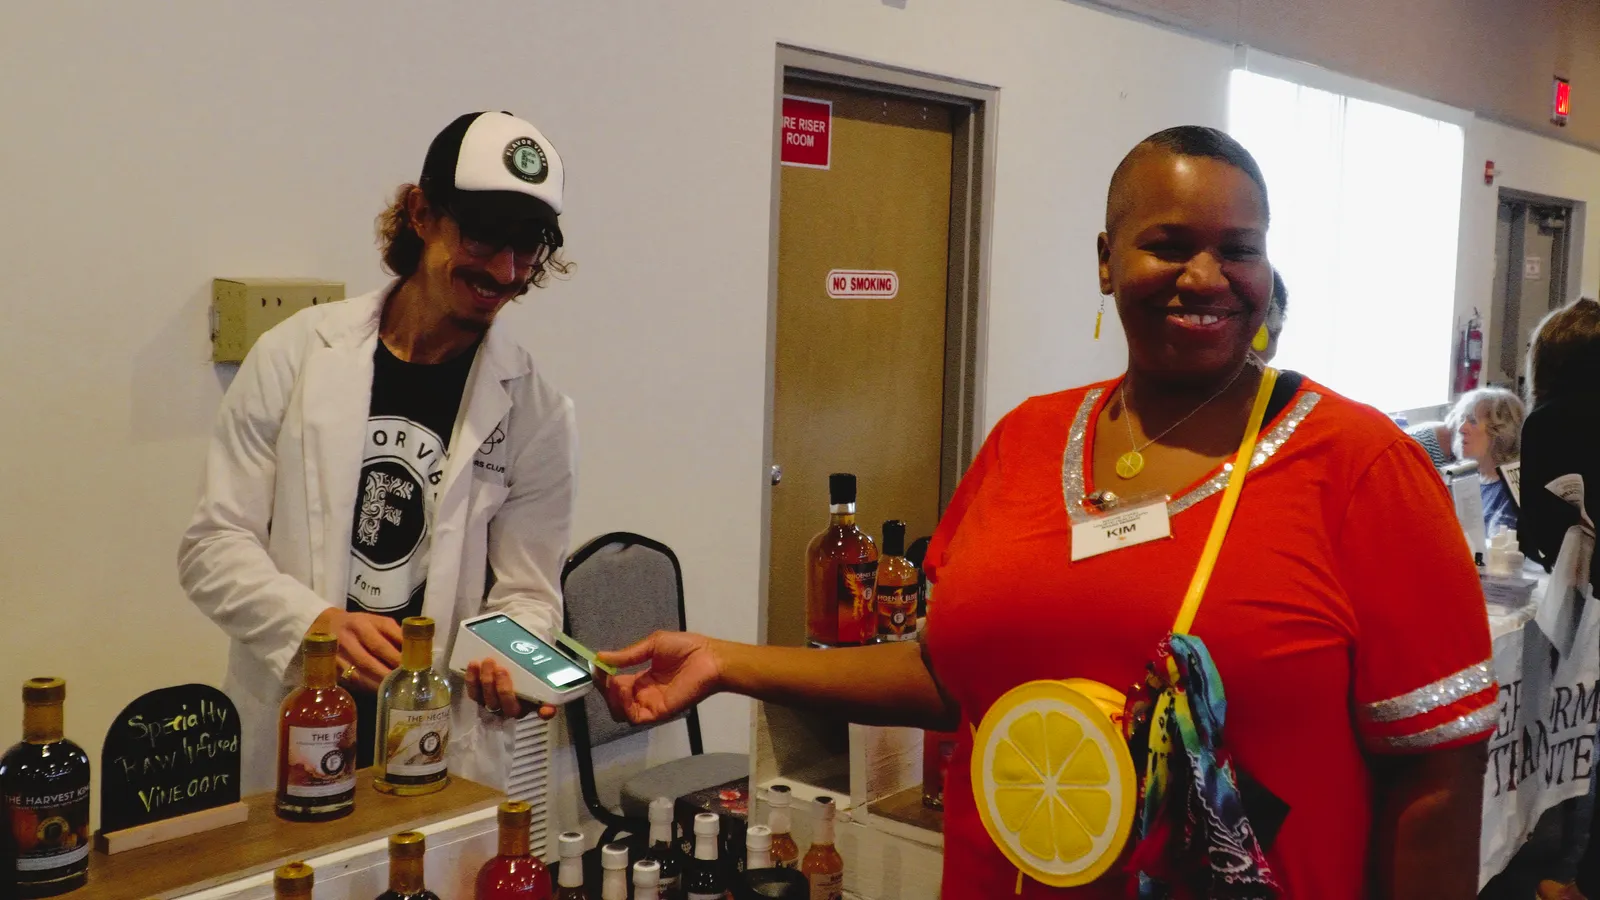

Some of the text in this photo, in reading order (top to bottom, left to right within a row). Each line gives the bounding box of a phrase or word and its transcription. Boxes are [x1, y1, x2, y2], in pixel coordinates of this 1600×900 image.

[798, 118, 826, 133] RISER
[786, 132, 814, 147] ROOM
[833, 277, 892, 292] NO SMOKING
[1107, 523, 1136, 538] KIM
[354, 574, 382, 597] farm
[26, 791, 75, 805] HARVEST
